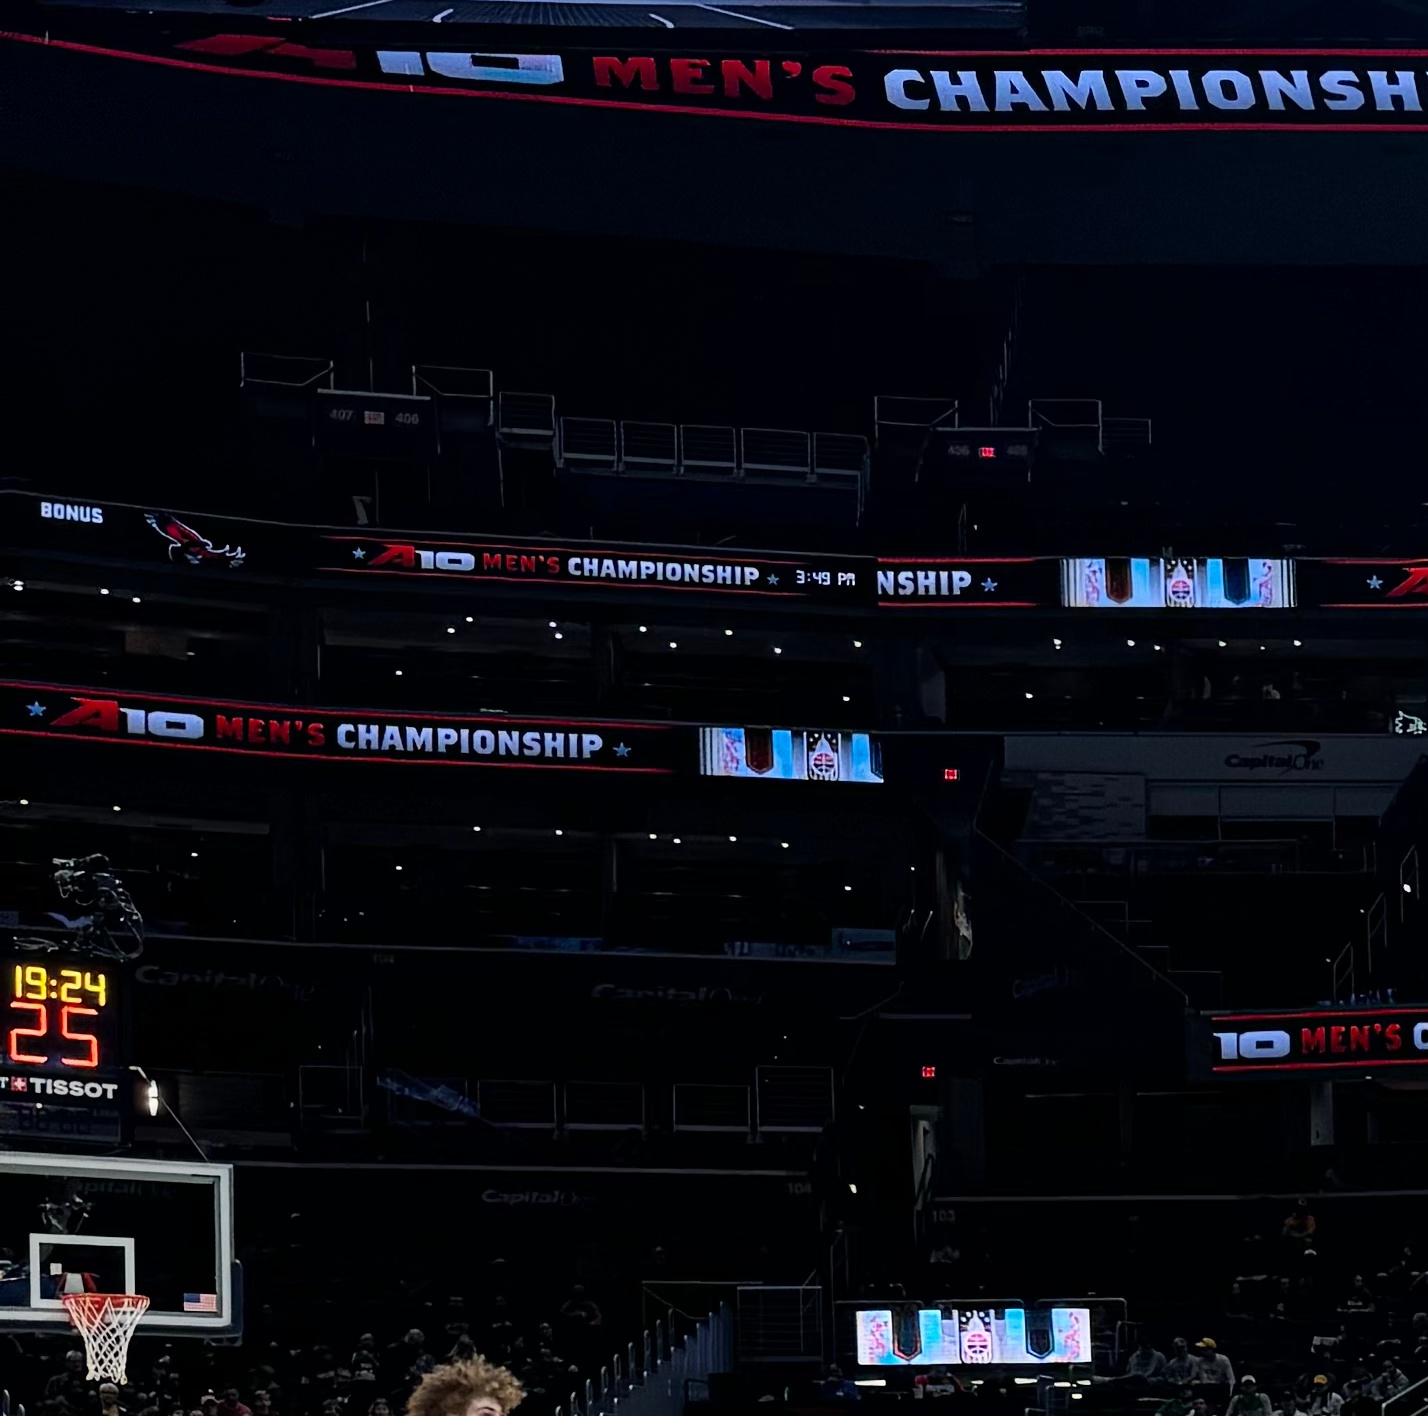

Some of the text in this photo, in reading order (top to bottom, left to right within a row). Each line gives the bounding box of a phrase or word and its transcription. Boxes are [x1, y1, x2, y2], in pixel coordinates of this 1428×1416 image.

[594, 56, 856, 106] MEN'S
[40, 501, 104, 525] BONUS
[367, 545, 760, 587] A10 MEN'S CHAMPIONSHIP
[796, 570, 831, 586] 3:49
[51, 697, 604, 760] A10 MEN'S CHAMPIONSHIP
[15, 964, 107, 1007] 19:24
[10, 1001, 99, 1068] 25
[1300, 1024, 1402, 1054] MEN'S
[29, 1077, 118, 1100] TISSOT
